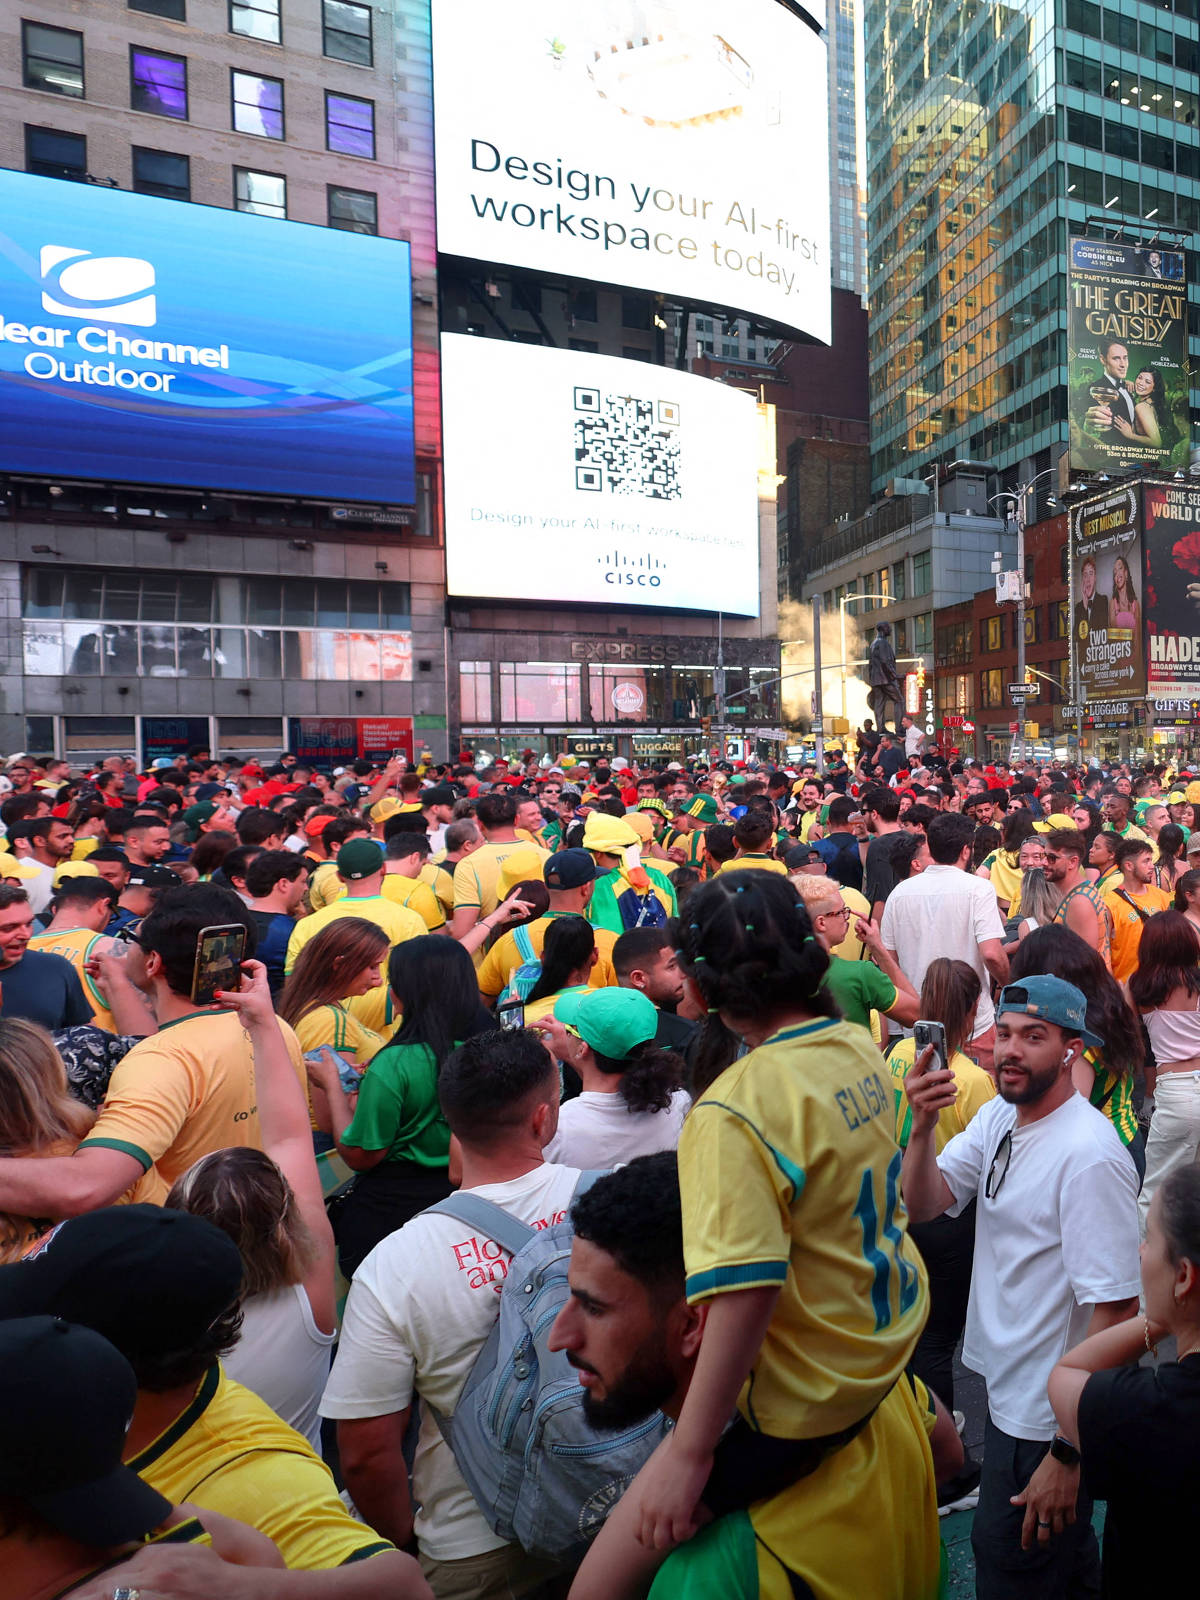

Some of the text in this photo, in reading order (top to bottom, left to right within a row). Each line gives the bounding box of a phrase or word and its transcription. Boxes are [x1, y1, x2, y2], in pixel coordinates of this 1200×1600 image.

[470, 138, 819, 266] Design your AI-first
[470, 193, 800, 296] workspace today.
[1077, 251, 1125, 263] CORBIN BLEU
[1084, 273, 1110, 282] PARTY'S
[1112, 277, 1139, 286] ROARING
[1152, 282, 1185, 292] BROADWAY
[1072, 283, 1185, 319] THE GREAT
[1085, 311, 1172, 341] GATSBY
[77, 326, 229, 369] Channel
[24, 352, 176, 392] Outdoor
[1111, 445, 1144, 453] BROADWAY
[1127, 452, 1159, 460] BROADWAY
[1166, 490, 1186, 503] COME
[470, 507, 533, 528] Design
[539, 514, 576, 529] your
[1151, 502, 1192, 521] WORLD
[1084, 519, 1099, 537] BEST
[1100, 509, 1127, 532] MUSICAL
[605, 572, 661, 587] CISCO
[1089, 627, 1107, 646] two
[571, 641, 680, 661] EXPRESS
[1086, 641, 1131, 664] strangers
[1151, 663, 1192, 671] BROADWAY'S
[926, 688, 934, 735] 1540
[1062, 702, 1129, 718] GIFTS LUGGAGE
[1155, 700, 1190, 711] GIFTS
[575, 743, 614, 752] GIFTS
[635, 743, 681, 751] LUGGAGE
[834, 1072, 889, 1132] ELISA
